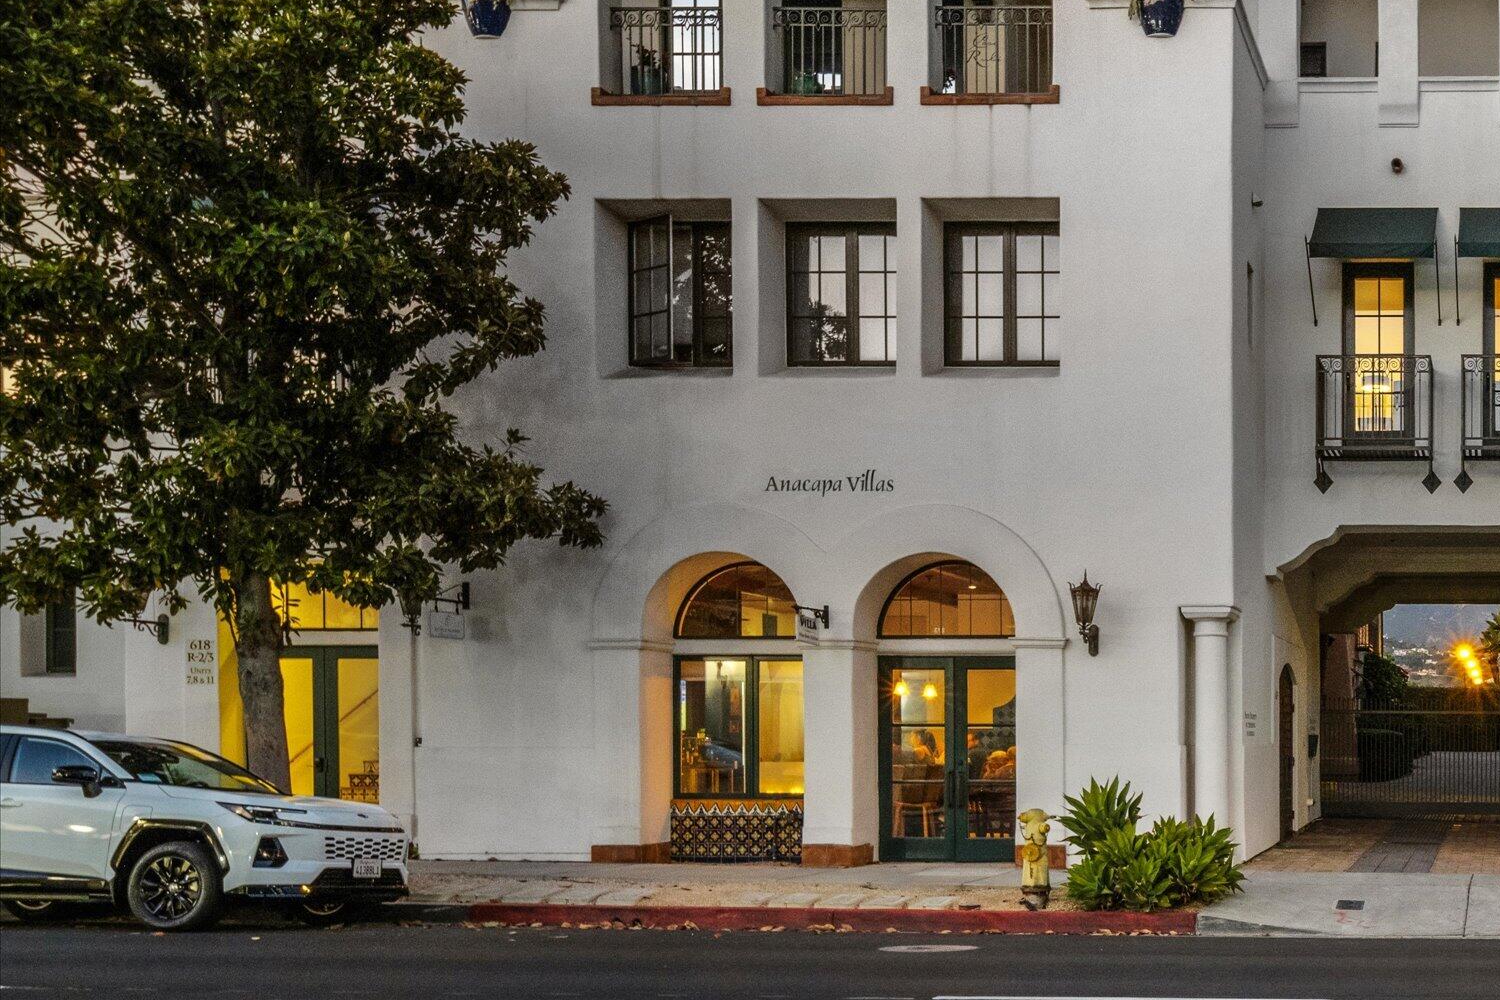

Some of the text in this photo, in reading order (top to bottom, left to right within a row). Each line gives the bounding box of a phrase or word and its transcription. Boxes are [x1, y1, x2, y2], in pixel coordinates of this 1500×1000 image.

[764, 469, 894, 497] Anacapa Villas
[800, 615, 817, 630] VILLA
[190, 640, 211, 650] 618
[187, 652, 214, 663] R-2/3
[207, 675, 214, 684] 11
